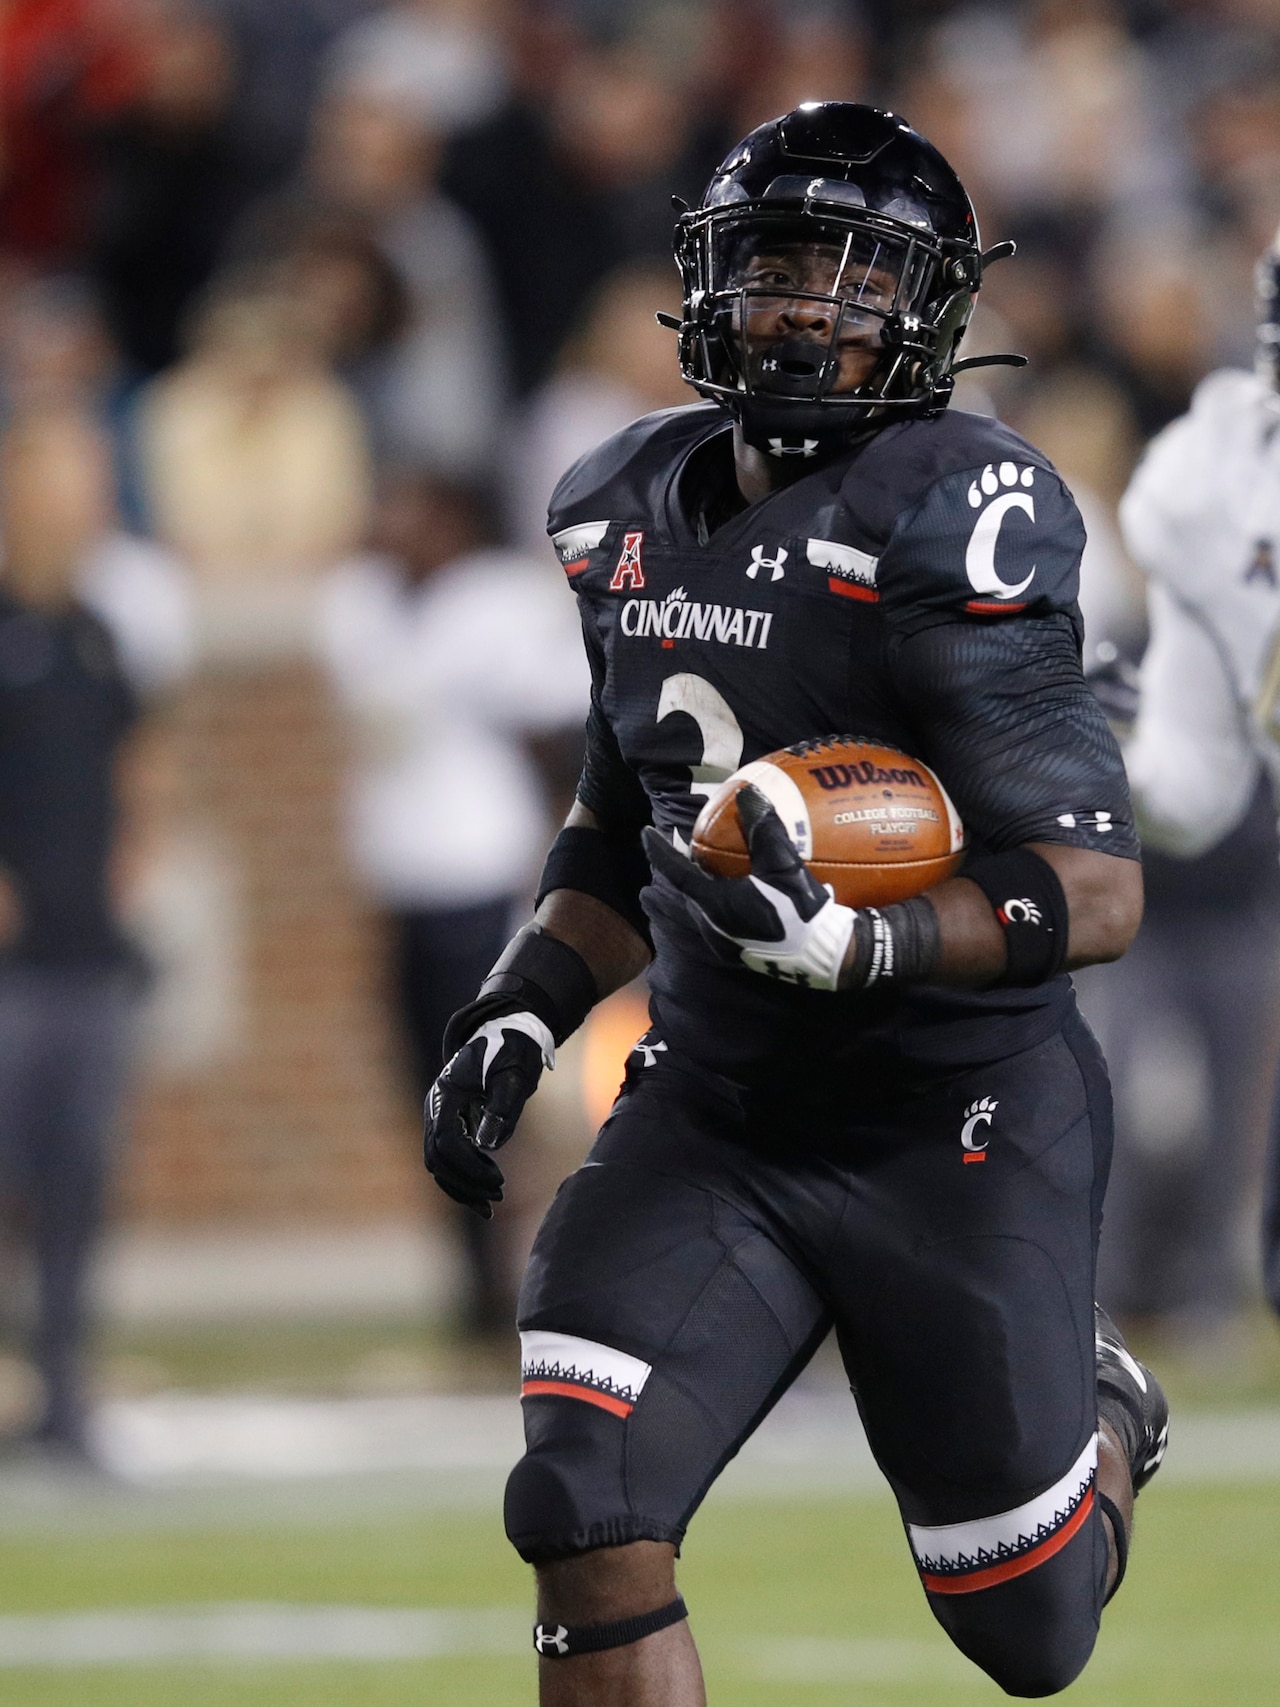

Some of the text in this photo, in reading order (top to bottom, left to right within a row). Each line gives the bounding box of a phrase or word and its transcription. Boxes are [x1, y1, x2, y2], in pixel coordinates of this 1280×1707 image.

[620, 597, 774, 649] CINCINNATI
[808, 760, 929, 790] Wilson
[834, 806, 939, 825] COLLEGE FOOTBALL
[870, 821, 917, 835] PLAYOFF
